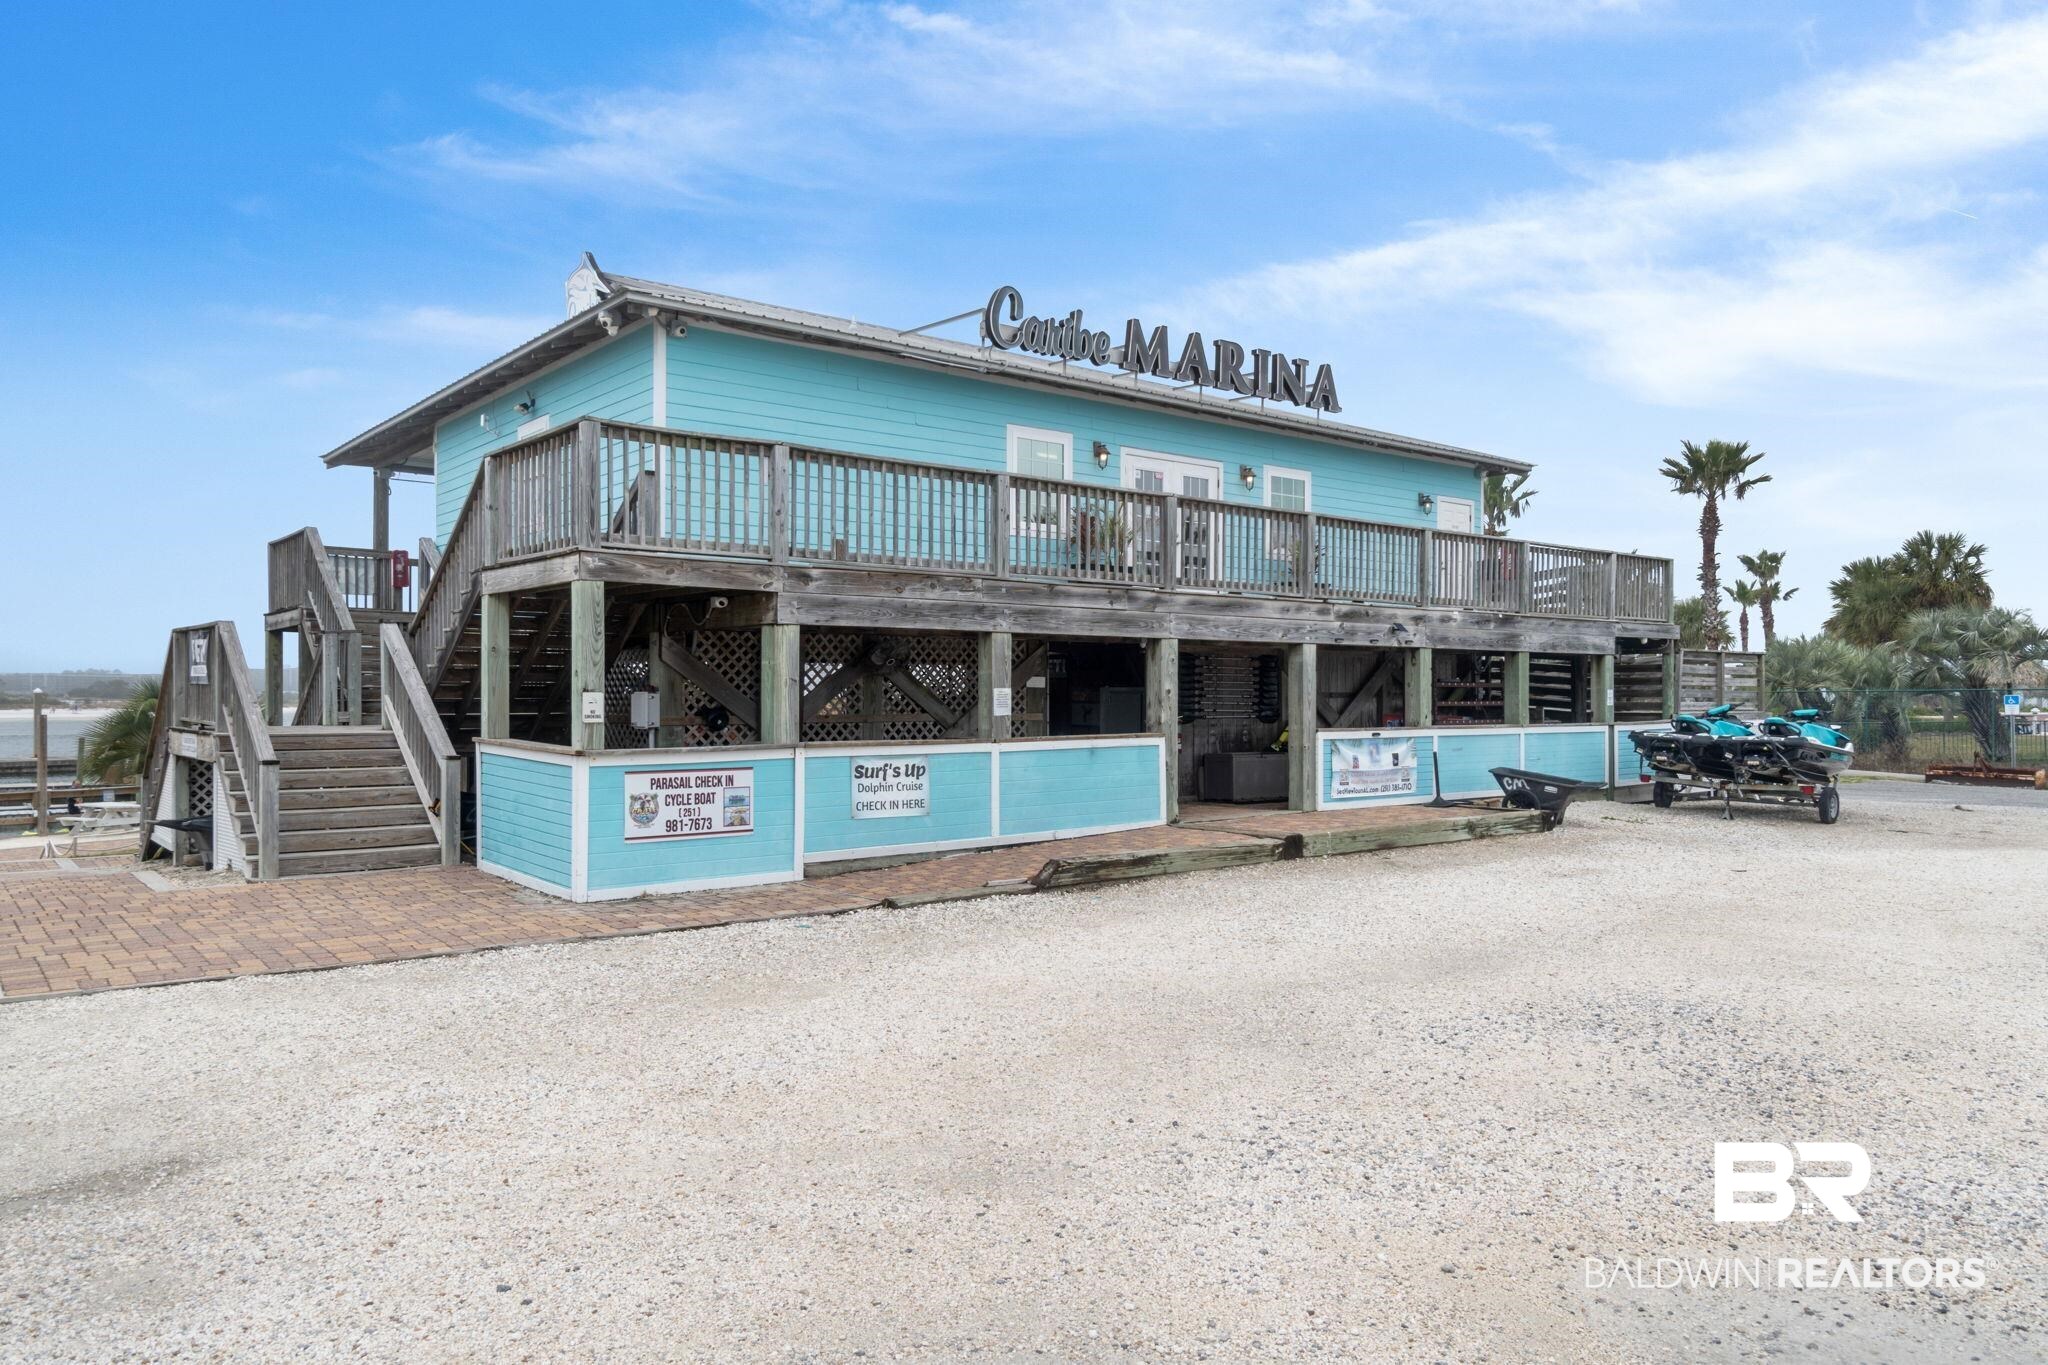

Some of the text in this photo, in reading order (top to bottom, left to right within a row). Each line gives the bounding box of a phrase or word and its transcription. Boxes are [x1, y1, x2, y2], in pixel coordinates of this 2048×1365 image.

[985, 285, 1343, 413] Caribe MARINA
[854, 763, 926, 781] Surf's Up
[650, 774, 734, 790] PARASAIL CHECK IN
[857, 781, 924, 795] Dolphin Cruise
[1502, 776, 1531, 791] CM
[664, 792, 716, 807] CYCLE BOAT
[856, 798, 926, 811] CHECK IN HERE
[665, 817, 713, 832] 981-7673
